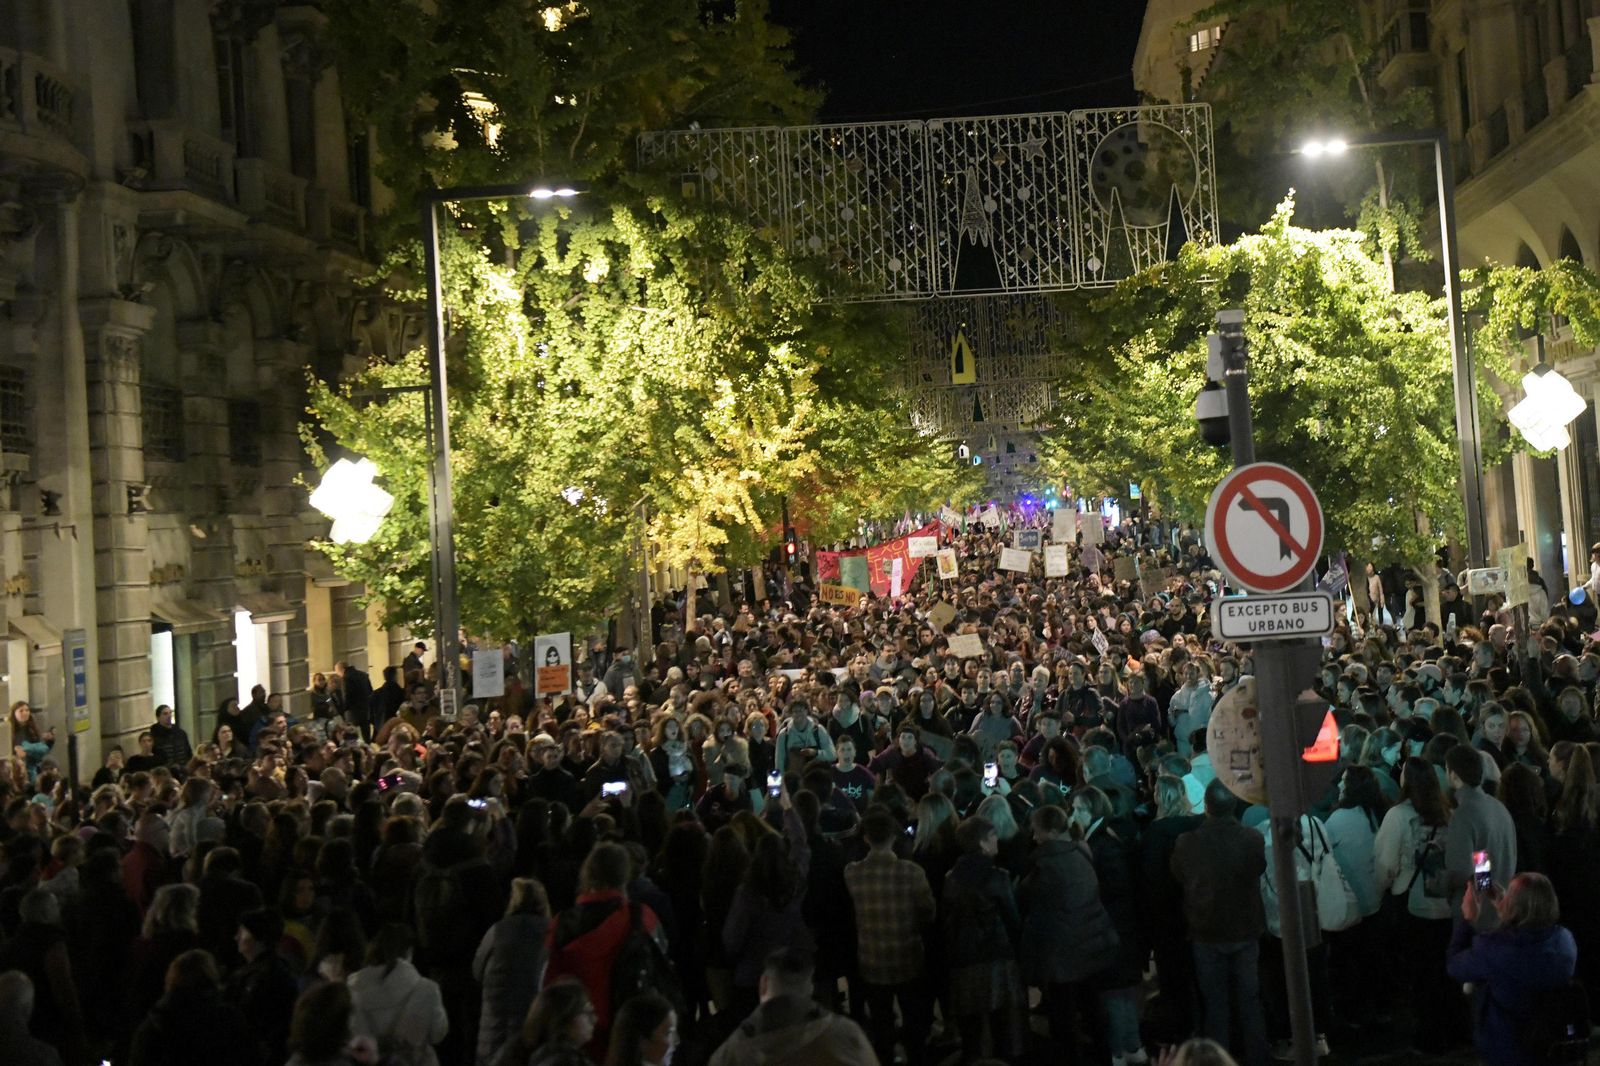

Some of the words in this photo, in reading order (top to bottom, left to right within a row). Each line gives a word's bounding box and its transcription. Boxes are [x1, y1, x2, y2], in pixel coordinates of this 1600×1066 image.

[821, 585, 833, 600] NO
[834, 589, 845, 600] ES
[845, 591, 856, 603] NO
[1228, 604, 1288, 617] EXCEPTO
[1292, 601, 1318, 613] BUS
[1248, 618, 1305, 632] URBANO
